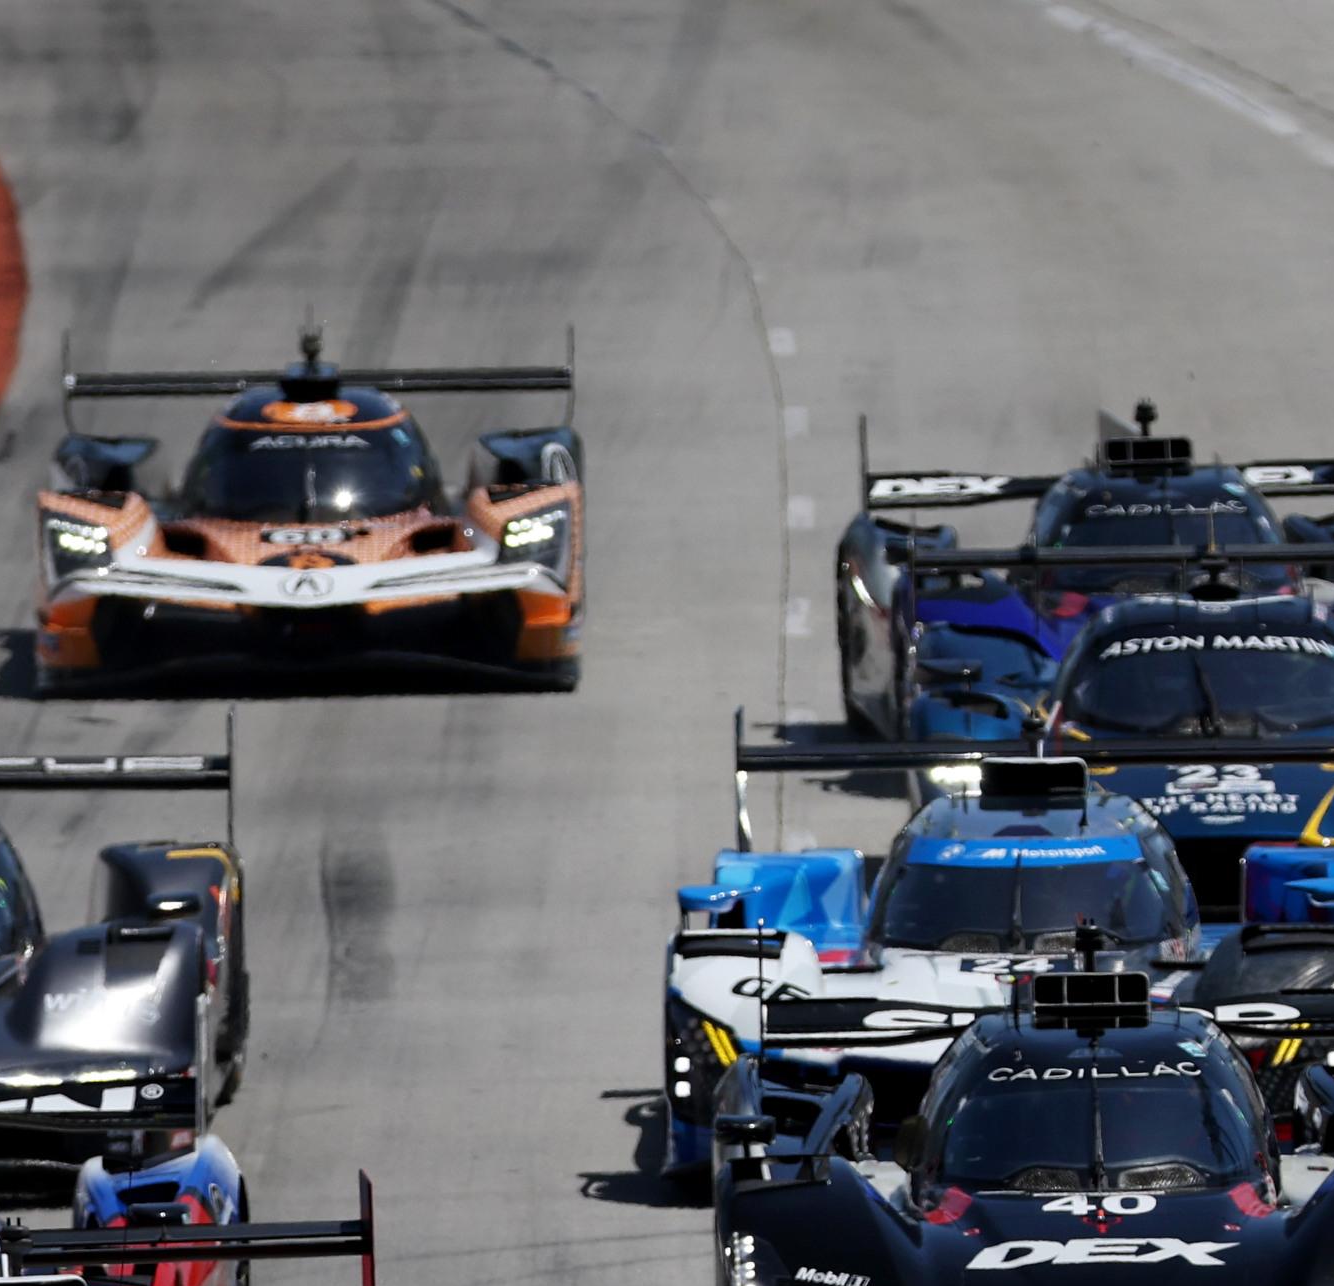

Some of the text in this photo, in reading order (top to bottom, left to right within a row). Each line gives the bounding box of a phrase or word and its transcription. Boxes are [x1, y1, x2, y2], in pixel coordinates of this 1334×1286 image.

[250, 435, 371, 450] ACURA
[870, 476, 1009, 498] DEX
[1085, 500, 1249, 517] CADILLAC
[269, 527, 346, 545] 60
[1099, 635, 1334, 661] ASTON MARTIN
[1177, 764, 1261, 787] 23
[1142, 793, 1299, 808] THE HEART
[1190, 802, 1298, 814] RACING
[1012, 845, 1106, 860] Motorsport
[971, 957, 1055, 974] 24
[987, 1062, 1202, 1082] CADILLAC
[1041, 1194, 1157, 1217] 40
[967, 1237, 1240, 1270] DEX
